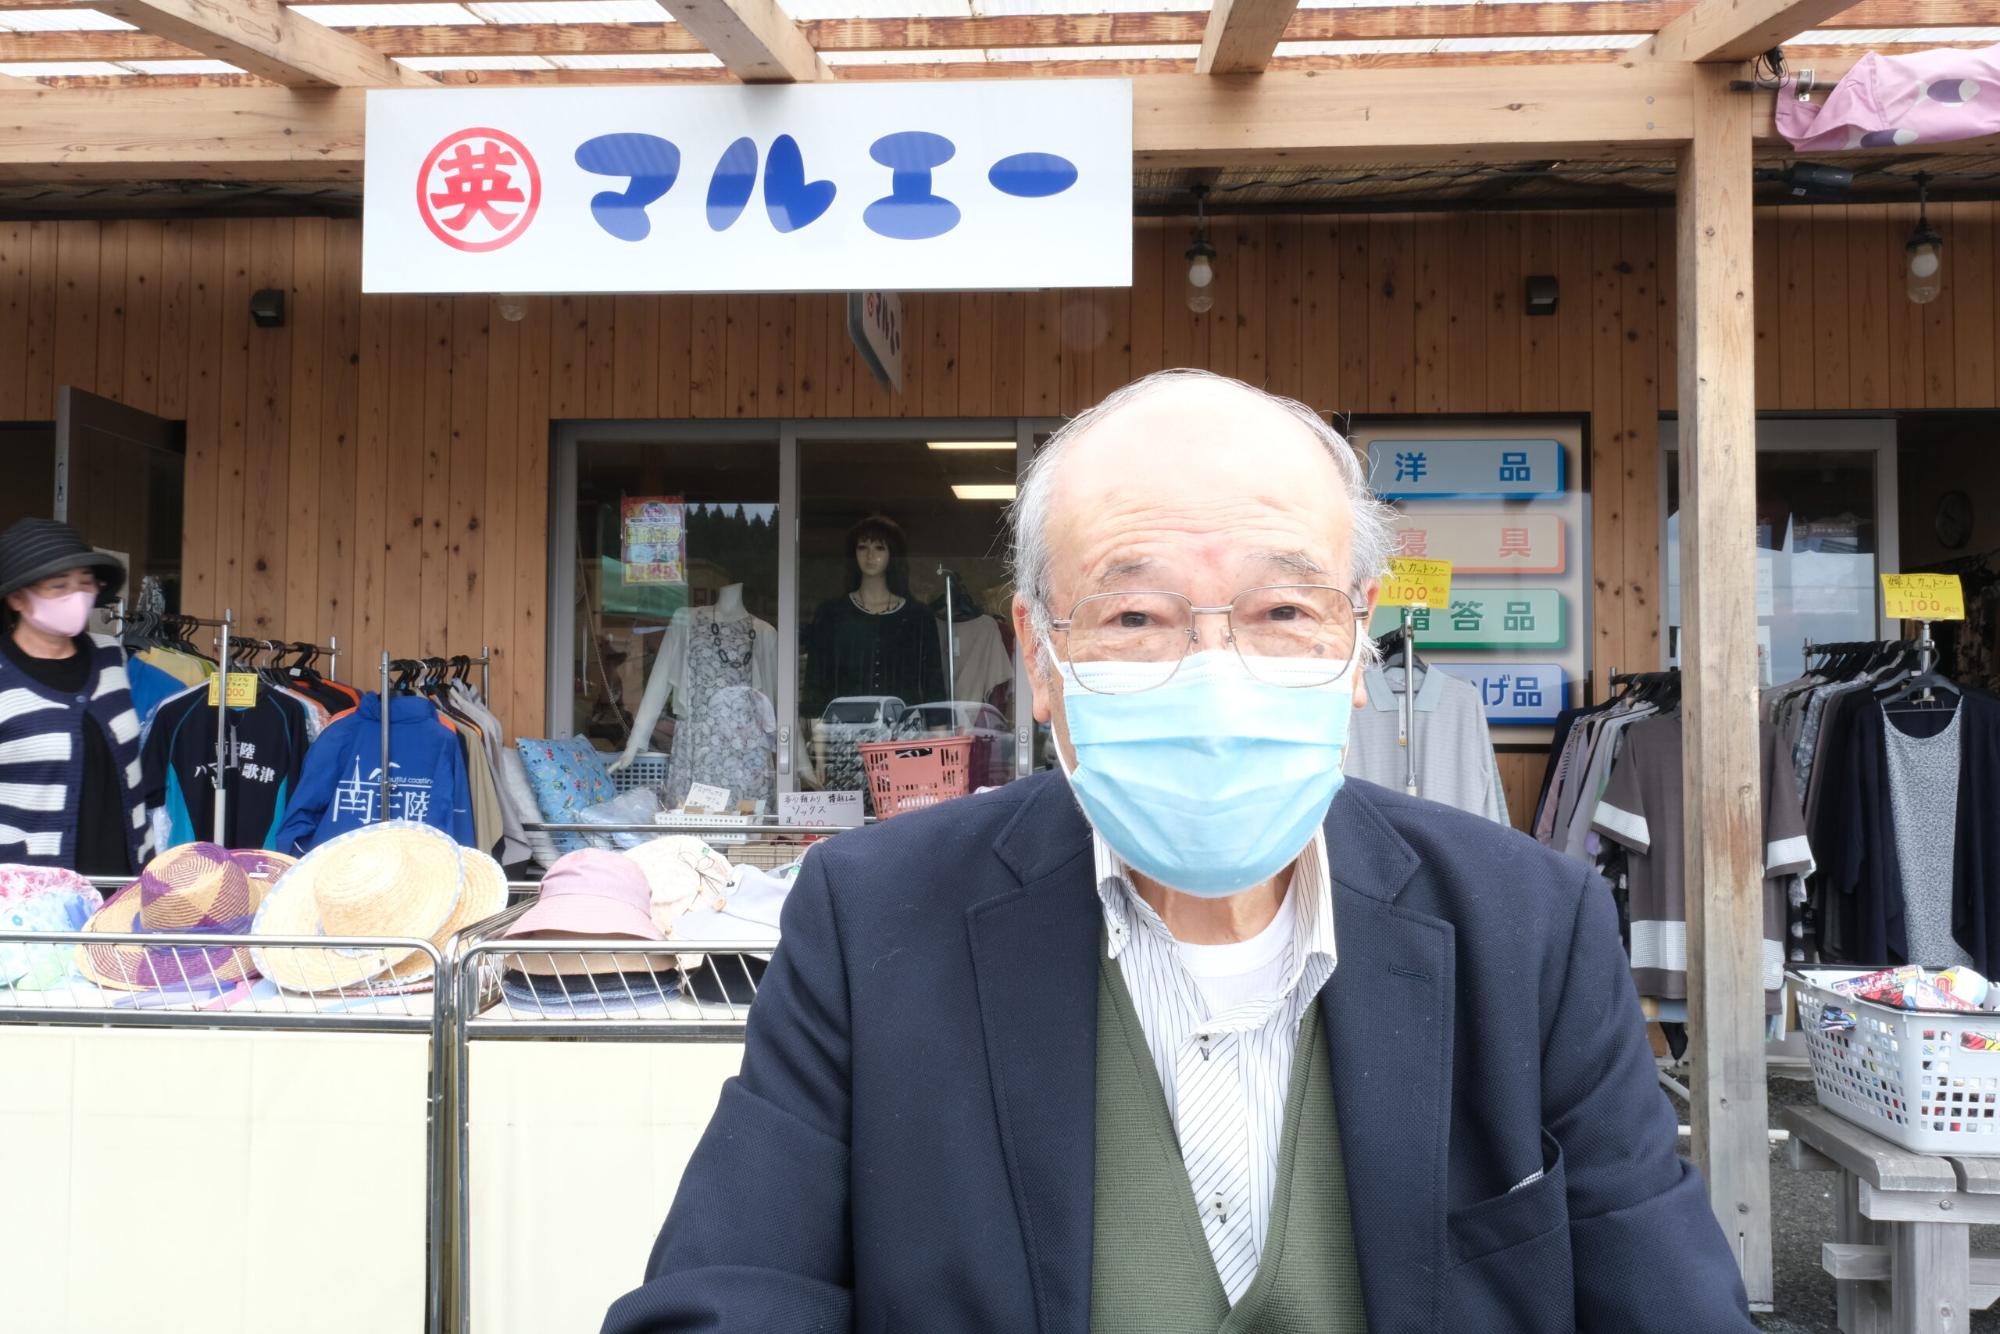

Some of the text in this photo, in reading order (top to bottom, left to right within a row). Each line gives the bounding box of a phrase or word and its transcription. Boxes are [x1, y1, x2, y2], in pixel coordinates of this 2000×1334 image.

[574, 131, 1079, 243] マルエー
[1395, 452, 1531, 483] 洋品
[1472, 674, 1543, 707] げ品
